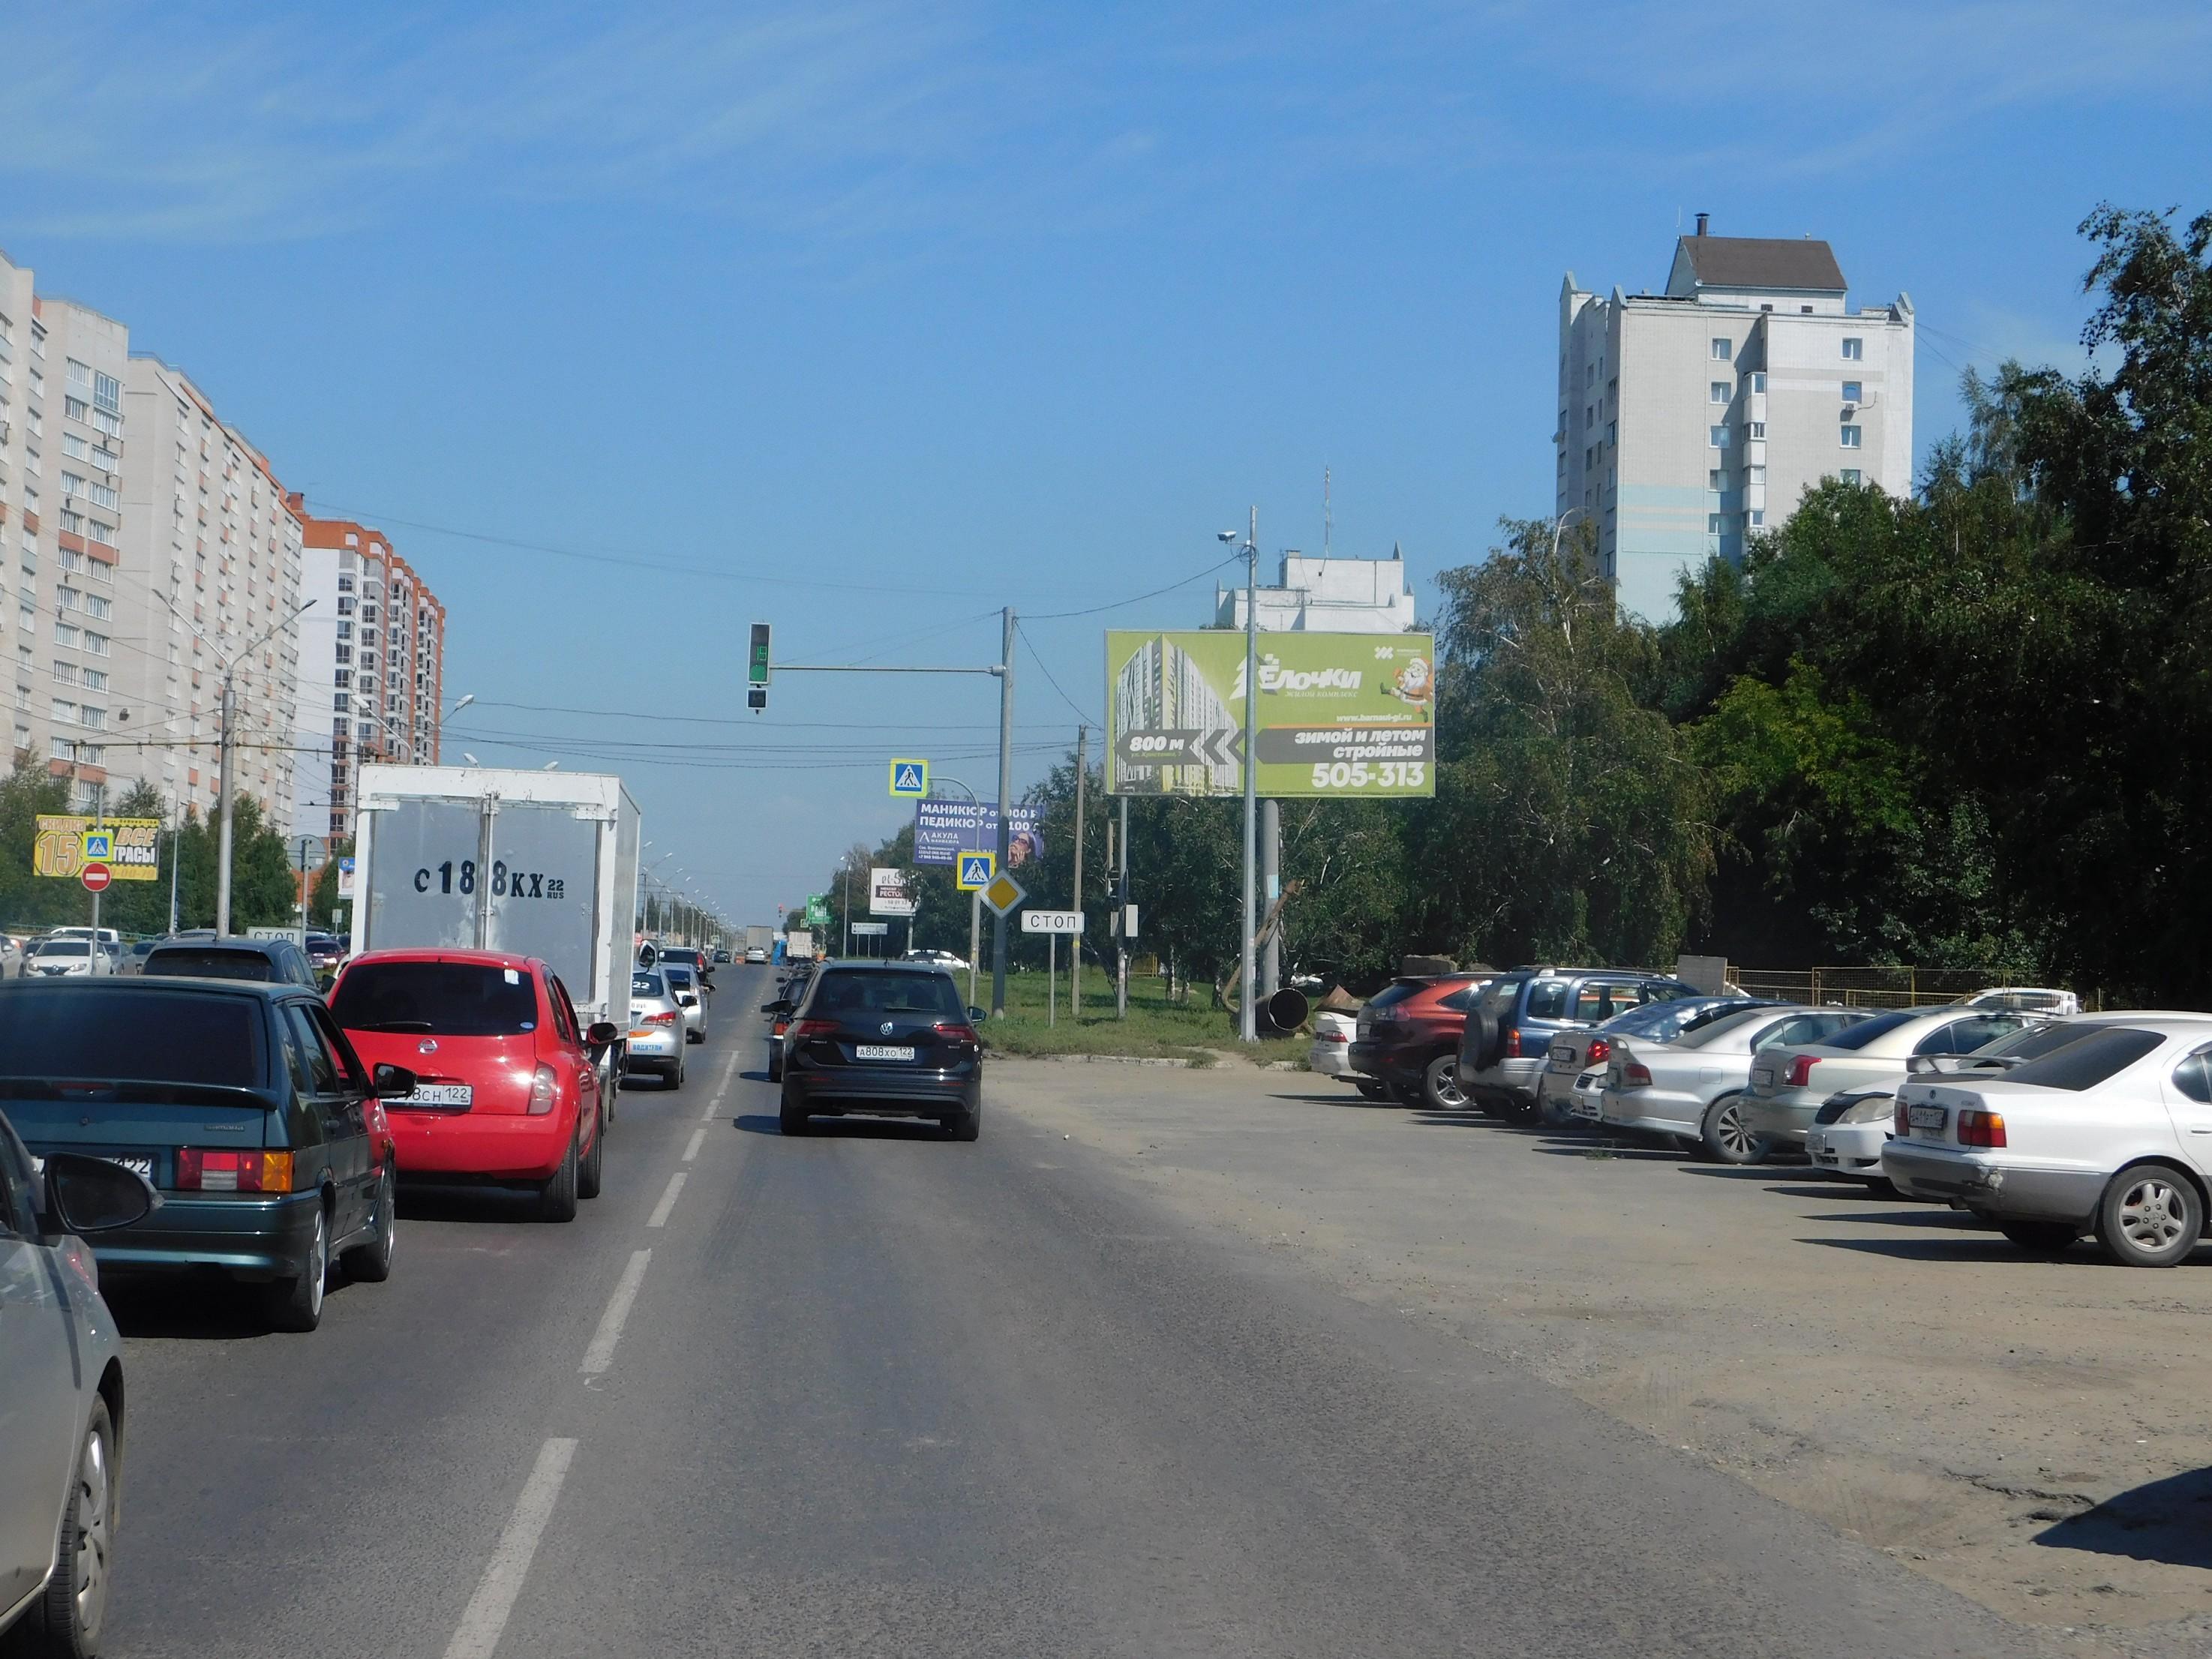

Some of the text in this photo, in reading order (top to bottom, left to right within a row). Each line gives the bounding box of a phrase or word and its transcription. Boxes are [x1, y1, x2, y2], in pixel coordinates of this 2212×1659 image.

[1295, 727, 1427, 744] зимой и летом
[1130, 736, 1167, 752] 800
[1333, 742, 1424, 760] стройные
[1311, 761, 1425, 788] 505-313
[921, 803, 987, 816] МАНИКЮР
[114, 826, 158, 847] ВСЕ
[931, 832, 959, 840] АКУЛА
[39, 833, 84, 875] 15
[113, 845, 155, 863] ТРАСЫ
[548, 879, 564, 891] 22
[1031, 915, 1076, 928] СТОП
[859, 1046, 913, 1058] А808ХО 122
[446, 1087, 467, 1099] 122
